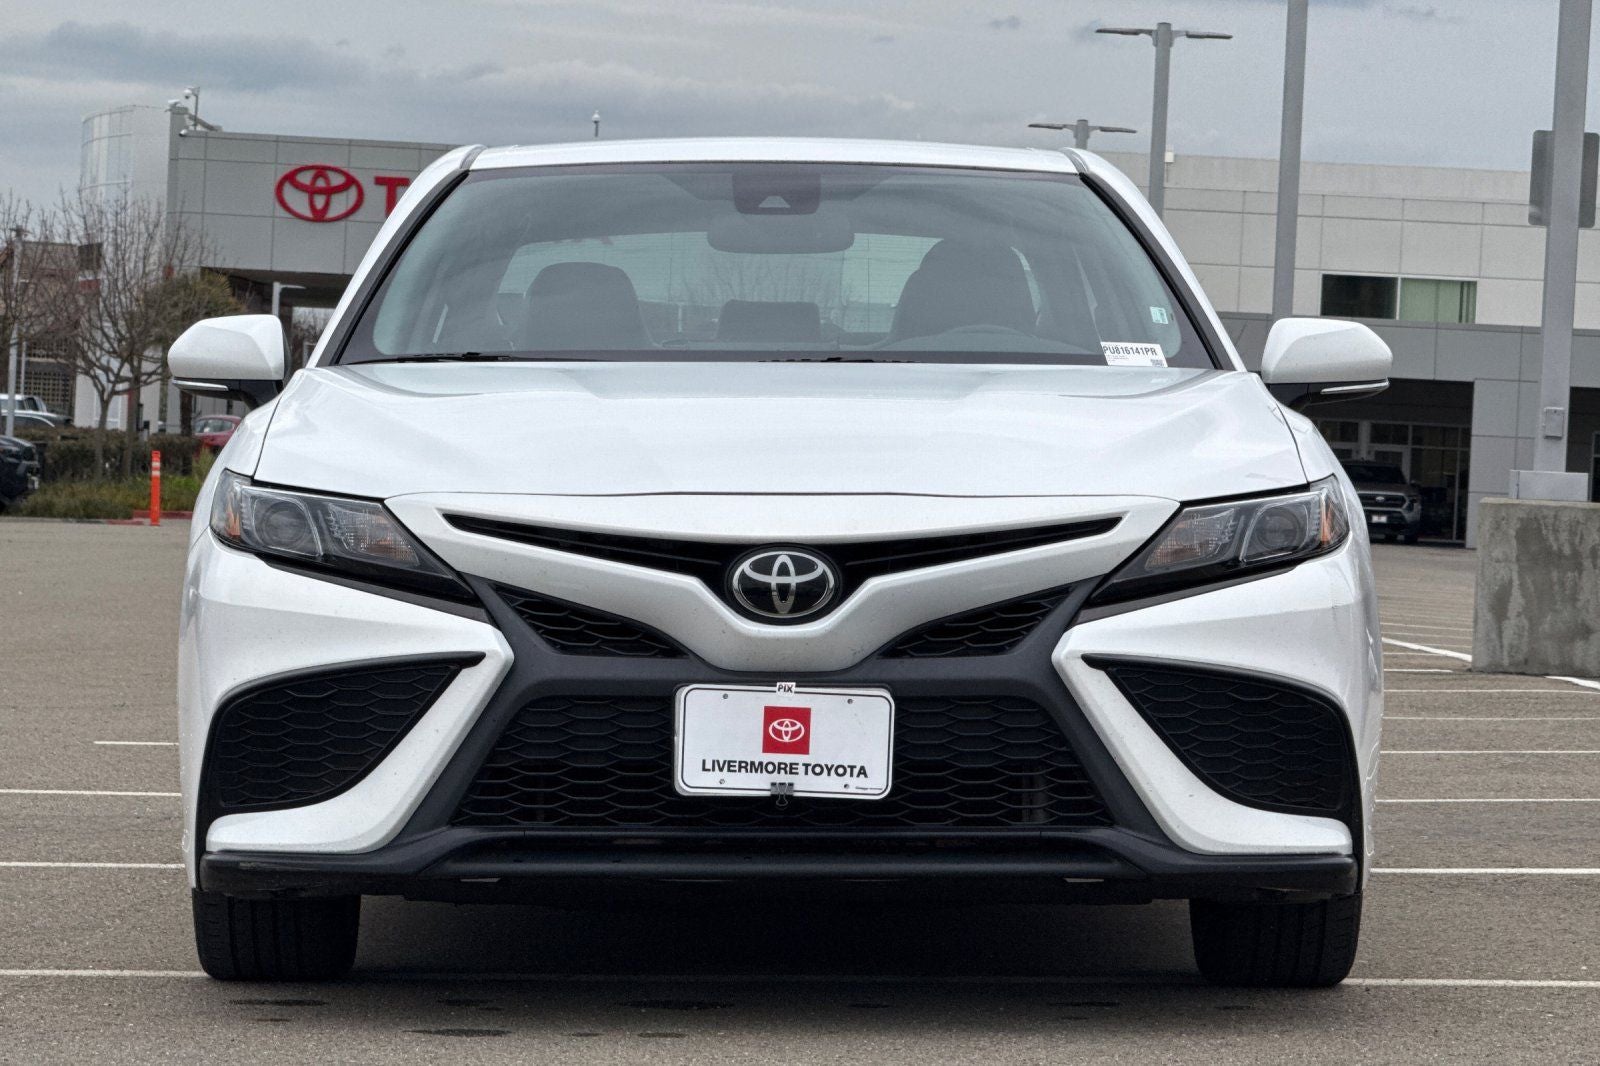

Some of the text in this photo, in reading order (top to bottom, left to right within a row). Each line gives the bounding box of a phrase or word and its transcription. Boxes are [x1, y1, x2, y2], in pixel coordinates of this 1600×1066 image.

[1102, 345, 1158, 356] PU816141PR
[777, 683, 794, 693] PIX
[701, 759, 868, 778] LIVERMORE TOYOTA
